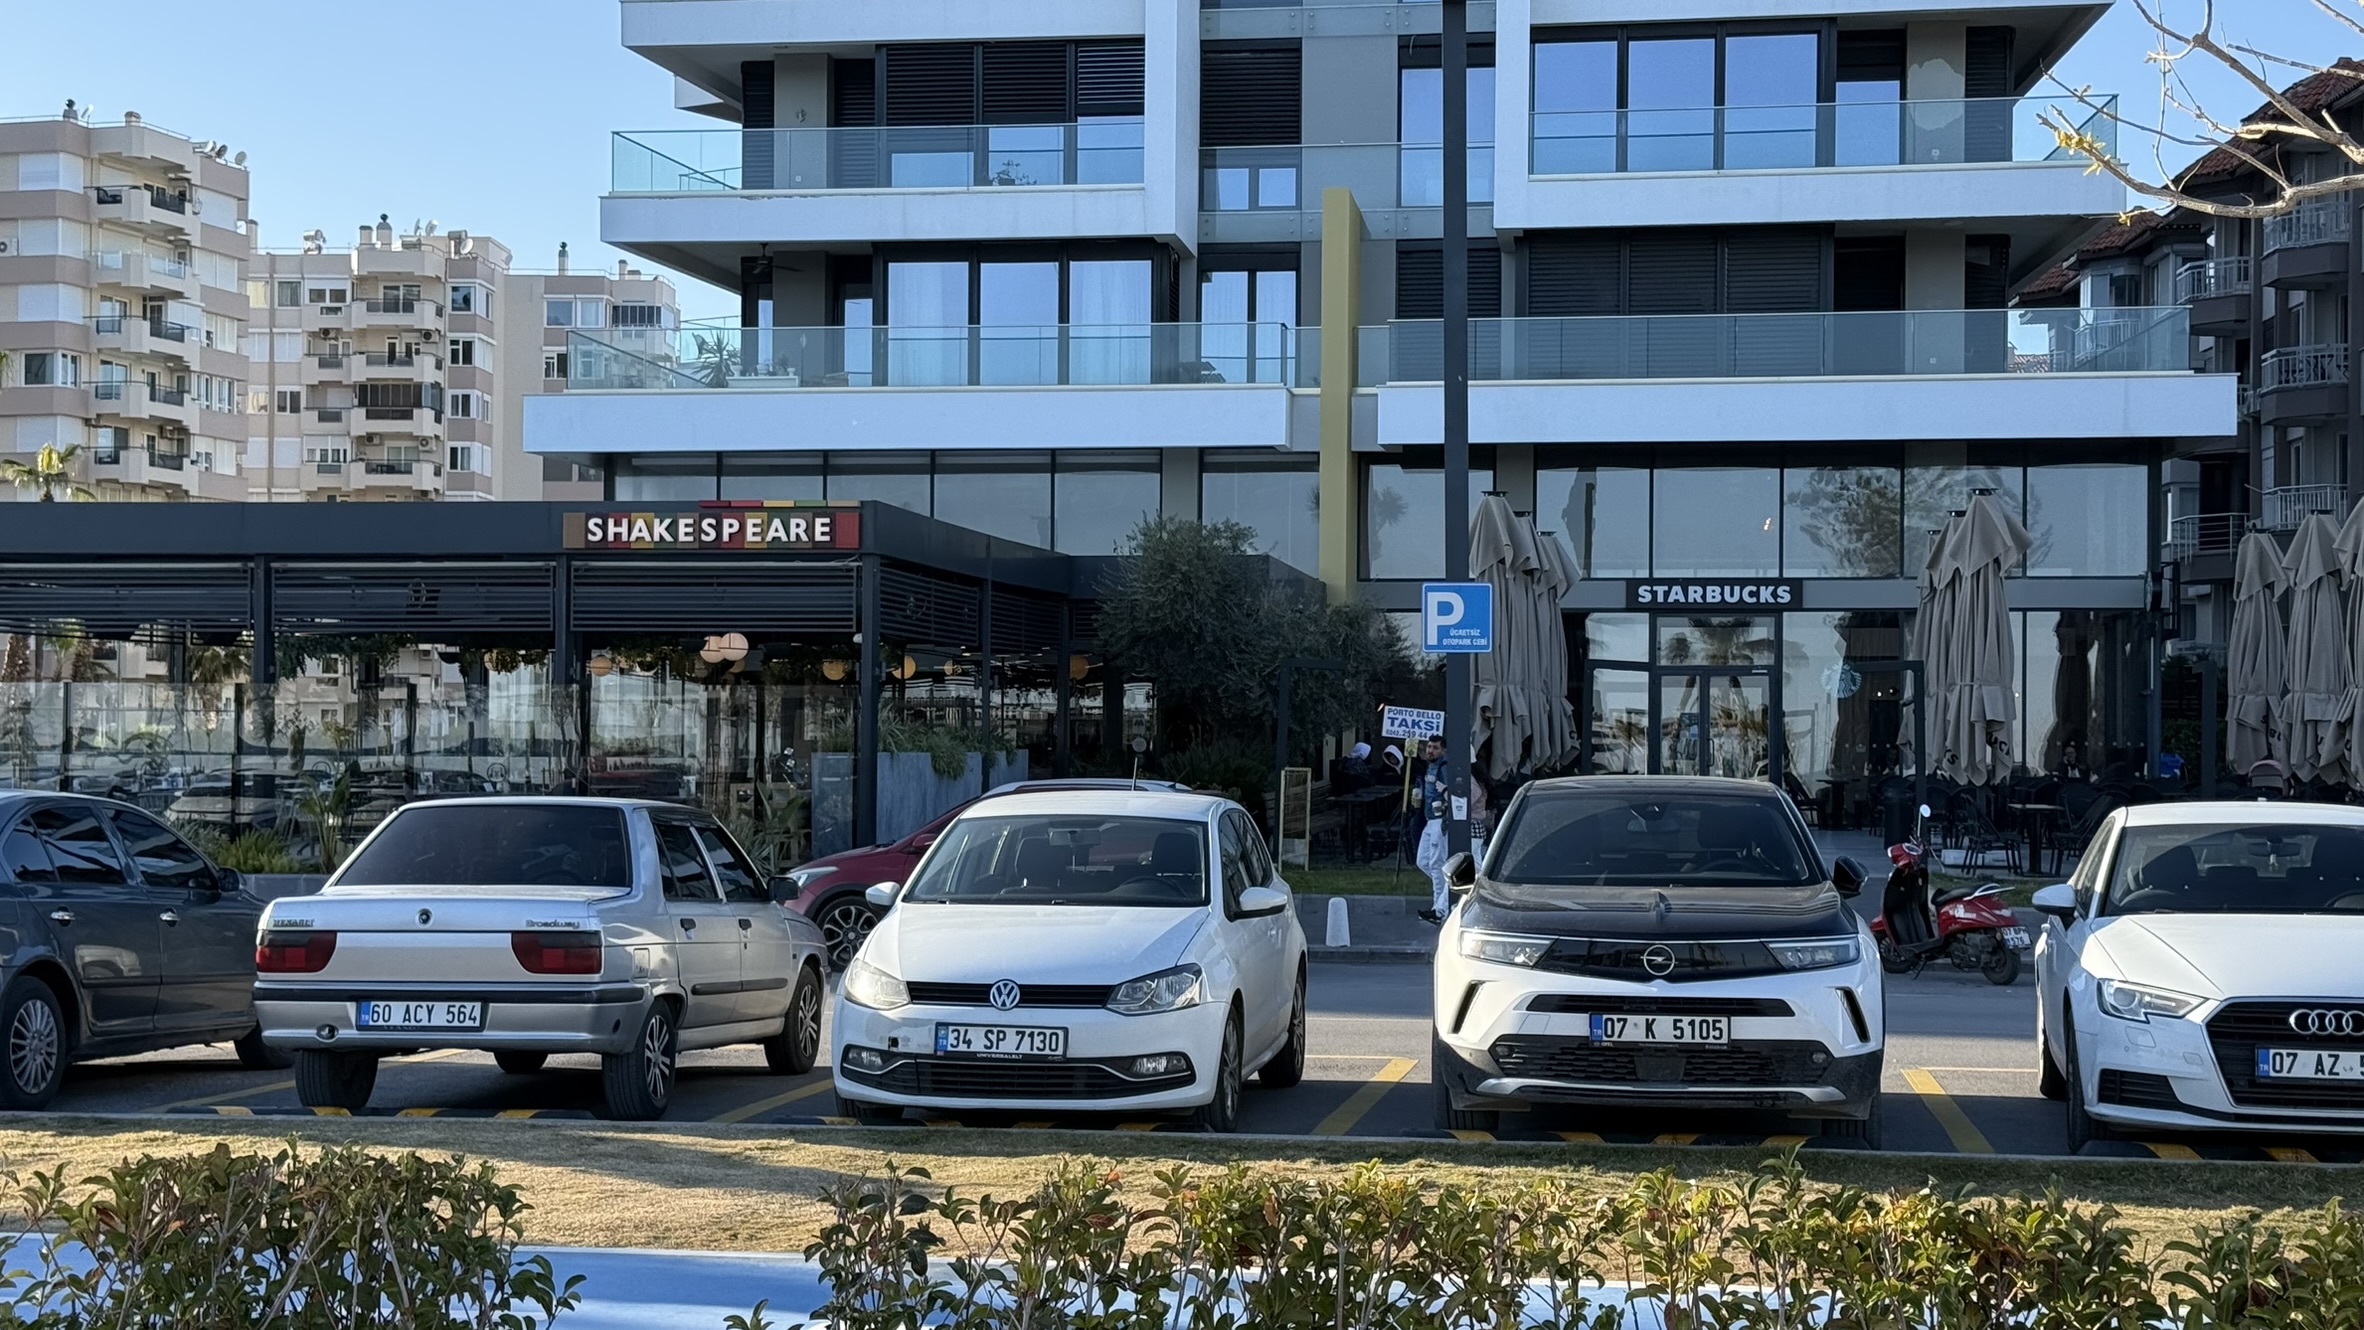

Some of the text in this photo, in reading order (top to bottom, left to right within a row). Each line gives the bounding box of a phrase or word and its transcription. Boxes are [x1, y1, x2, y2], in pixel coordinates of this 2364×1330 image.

[587, 518, 831, 543] SHAKESPEARE
[1638, 585, 1792, 604] STARBUCKS
[1427, 592, 1465, 646] P
[1443, 638, 1471, 646] OTOPARK
[1388, 708, 1441, 720] PORTO BELLO
[525, 919, 580, 929] Broadway
[371, 1004, 392, 1024] 60
[402, 1004, 435, 1024] ACY
[446, 1004, 478, 1025] 564
[1604, 1017, 1628, 1039] 07
[1645, 1018, 1657, 1040] K
[1672, 1018, 1724, 1041] 5105
[949, 1028, 973, 1050] 34
[983, 1029, 1007, 1051] SP
[1015, 1030, 1060, 1053] 7130
[2259, 1063, 2269, 1072] TR
[2271, 1051, 2299, 1075] 07
[2313, 1053, 2340, 1077] AZ
